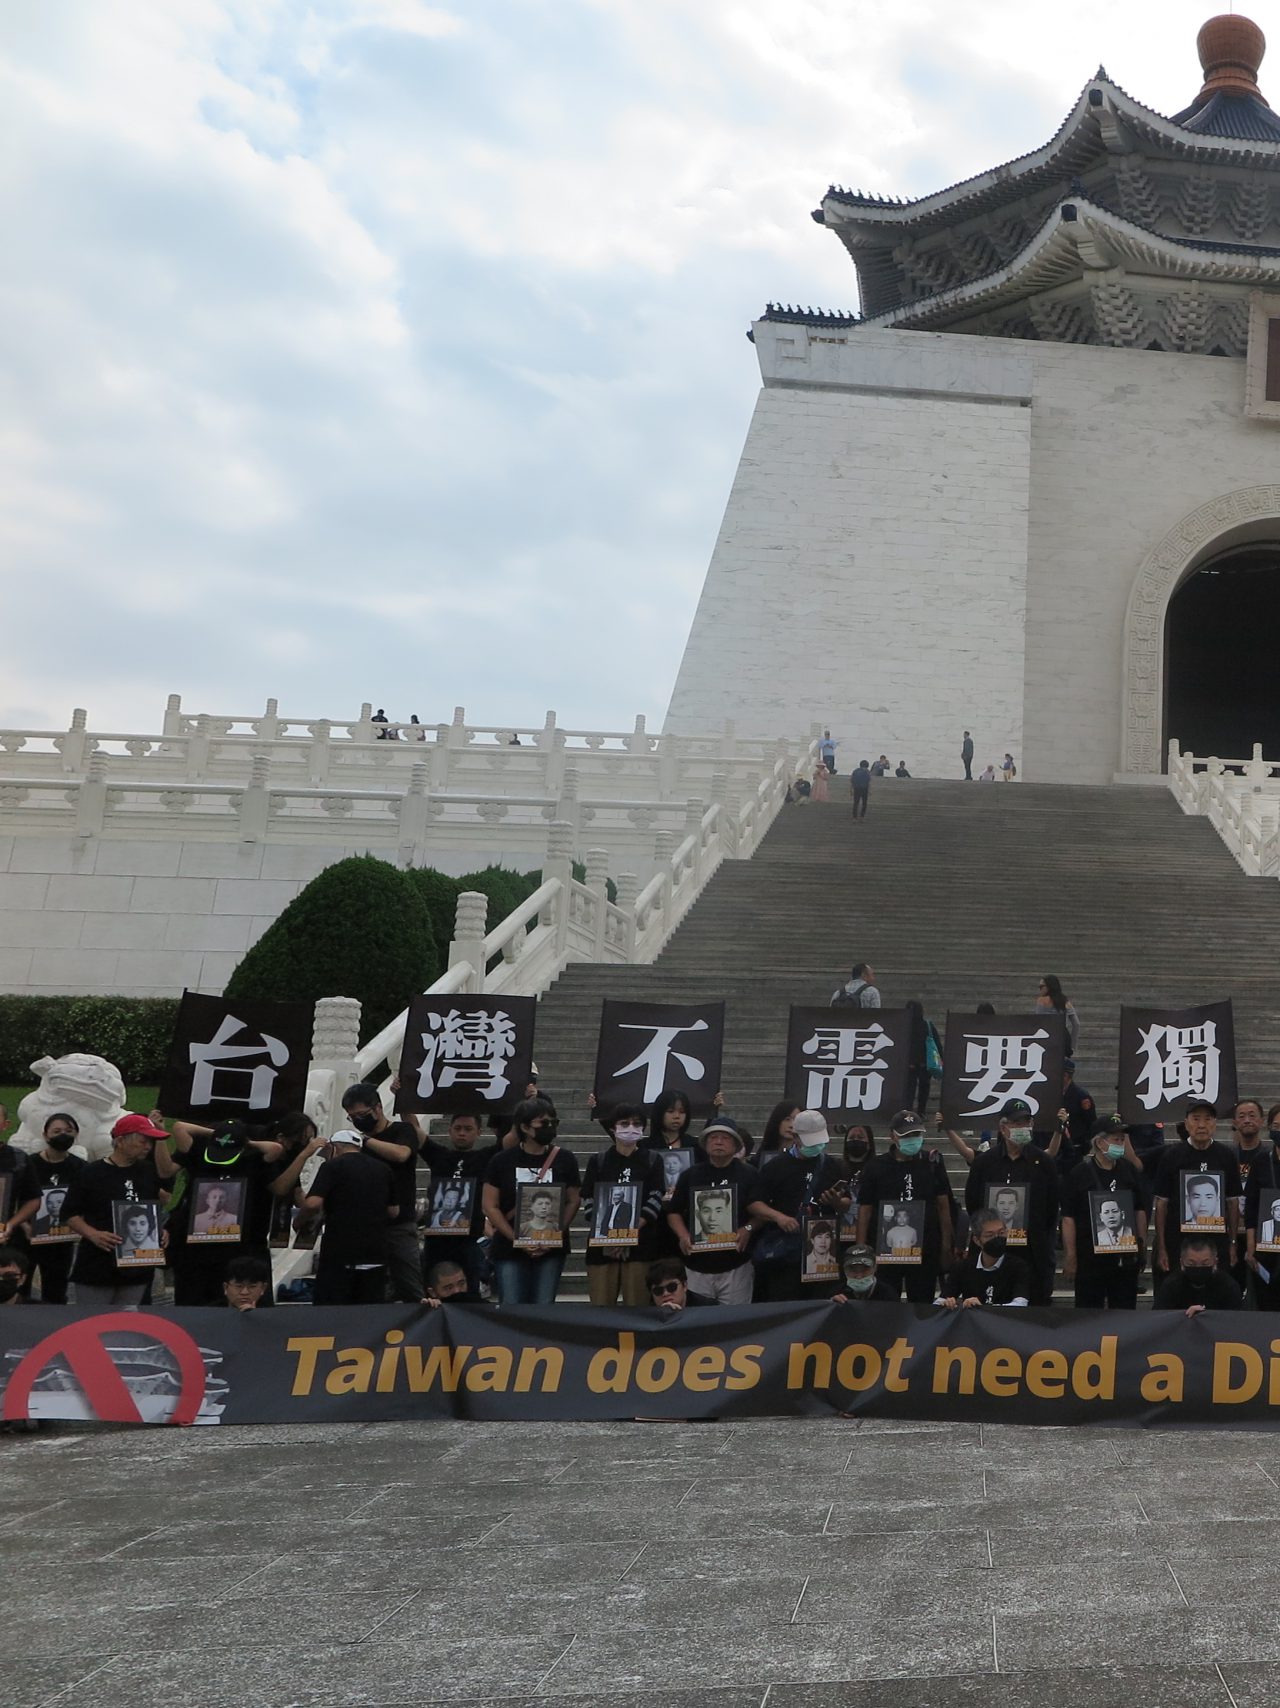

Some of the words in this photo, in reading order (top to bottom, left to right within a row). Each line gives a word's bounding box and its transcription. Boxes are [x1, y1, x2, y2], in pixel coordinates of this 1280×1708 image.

[189, 1014, 290, 1110] 台
[415, 1009, 517, 1101] 灣
[612, 1019, 709, 1104] 不
[801, 1022, 895, 1111] 需
[958, 1029, 1049, 1117] 要
[1134, 1020, 1221, 1110] 獨
[286, 1330, 564, 1396] Taiwan
[587, 1332, 763, 1393] does
[787, 1338, 914, 1393] not
[933, 1335, 1118, 1400] need
[1140, 1353, 1185, 1402] a
